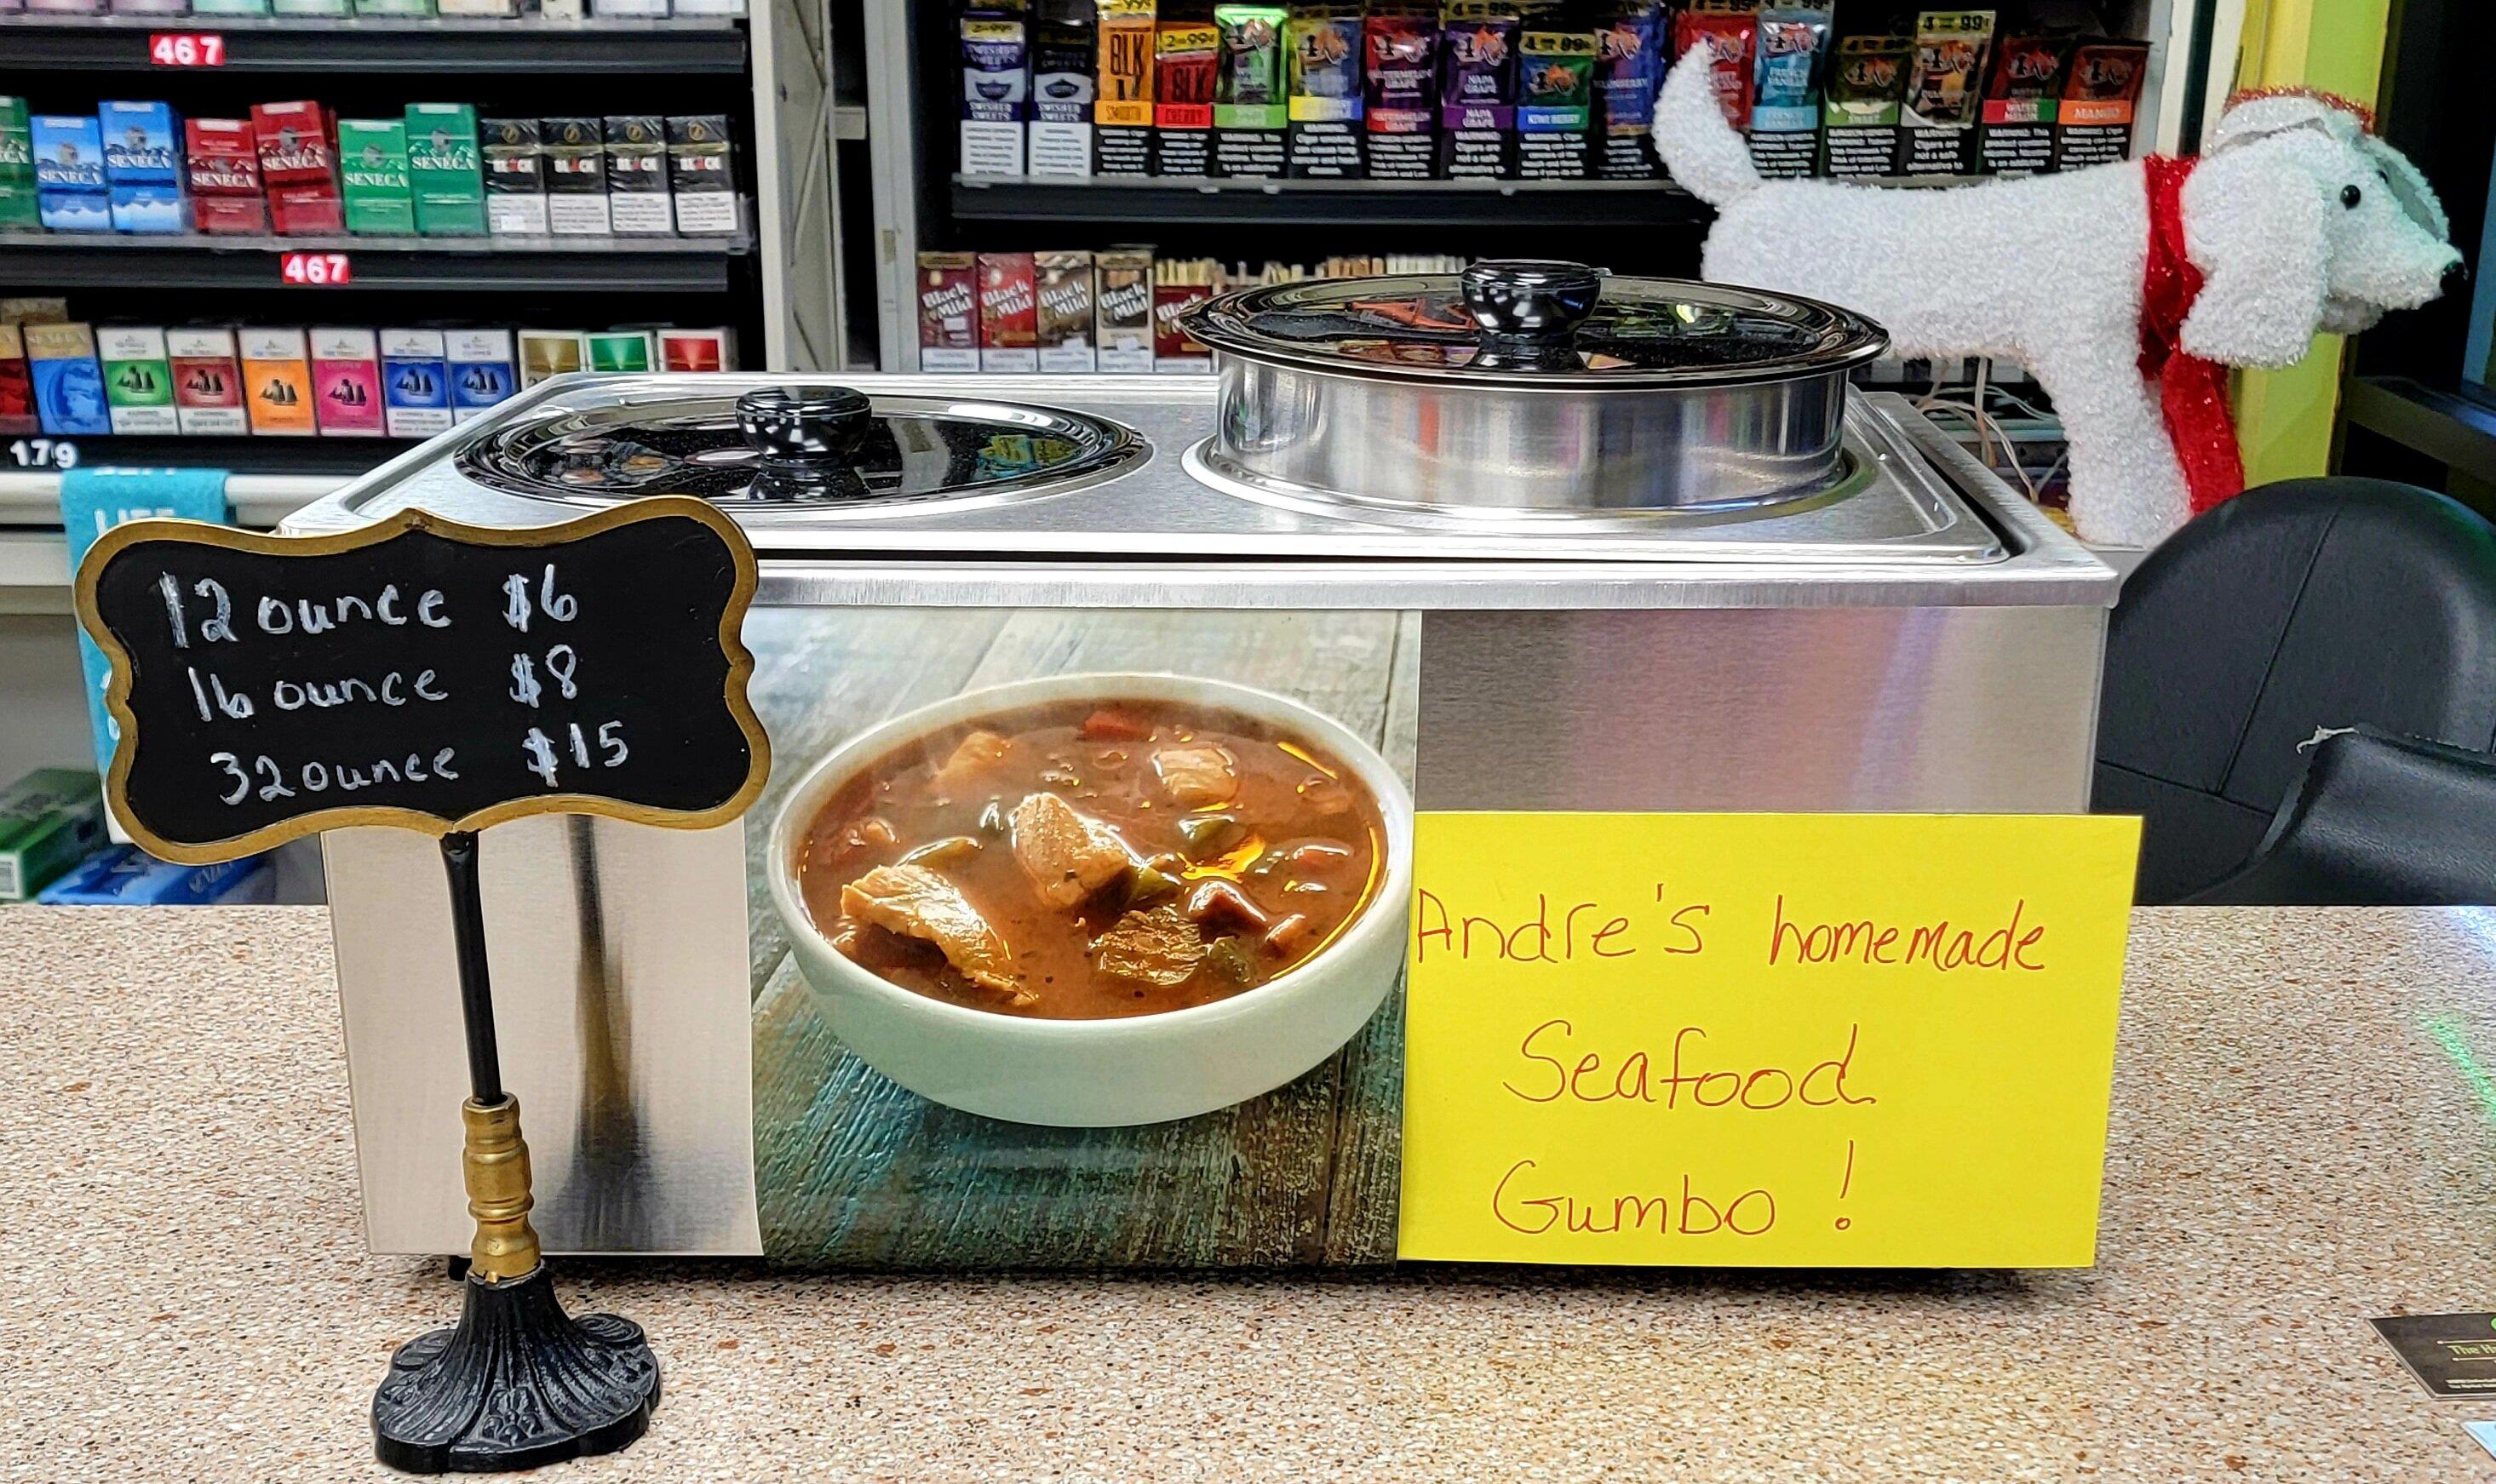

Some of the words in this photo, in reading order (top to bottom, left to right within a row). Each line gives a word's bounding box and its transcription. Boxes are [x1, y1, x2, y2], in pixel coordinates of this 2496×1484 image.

[153, 35, 223, 65] 467
[2074, 107, 2121, 121] MANGO
[107, 152, 171, 170] SENECA
[262, 155, 327, 171] SENECA
[412, 156, 475, 171] SENECA
[38, 169, 103, 185] SENECA
[192, 173, 254, 188] SENECA
[344, 173, 408, 188] SENECA
[284, 255, 348, 284] 467
[922, 282, 971, 307] Black
[981, 280, 1030, 307] Black
[1040, 281, 1087, 308] Black
[1099, 282, 1146, 308] Black
[938, 297, 973, 320] Mild
[996, 295, 1035, 320] Mild
[1053, 296, 1091, 320] Mild
[1114, 296, 1150, 320] Mild
[9, 438, 77, 468] 179
[159, 570, 238, 649] 12
[257, 584, 452, 634] ounce
[502, 563, 577, 633] $6
[187, 666, 255, 722] 16
[273, 669, 449, 711] ounce
[509, 644, 577, 708] $8
[521, 719, 628, 788] $15
[1417, 883, 1710, 964] Andre's
[1770, 894, 2046, 971] homemade
[1503, 1020, 1877, 1110] Seafood
[2447, 1345, 2479, 1355] The
